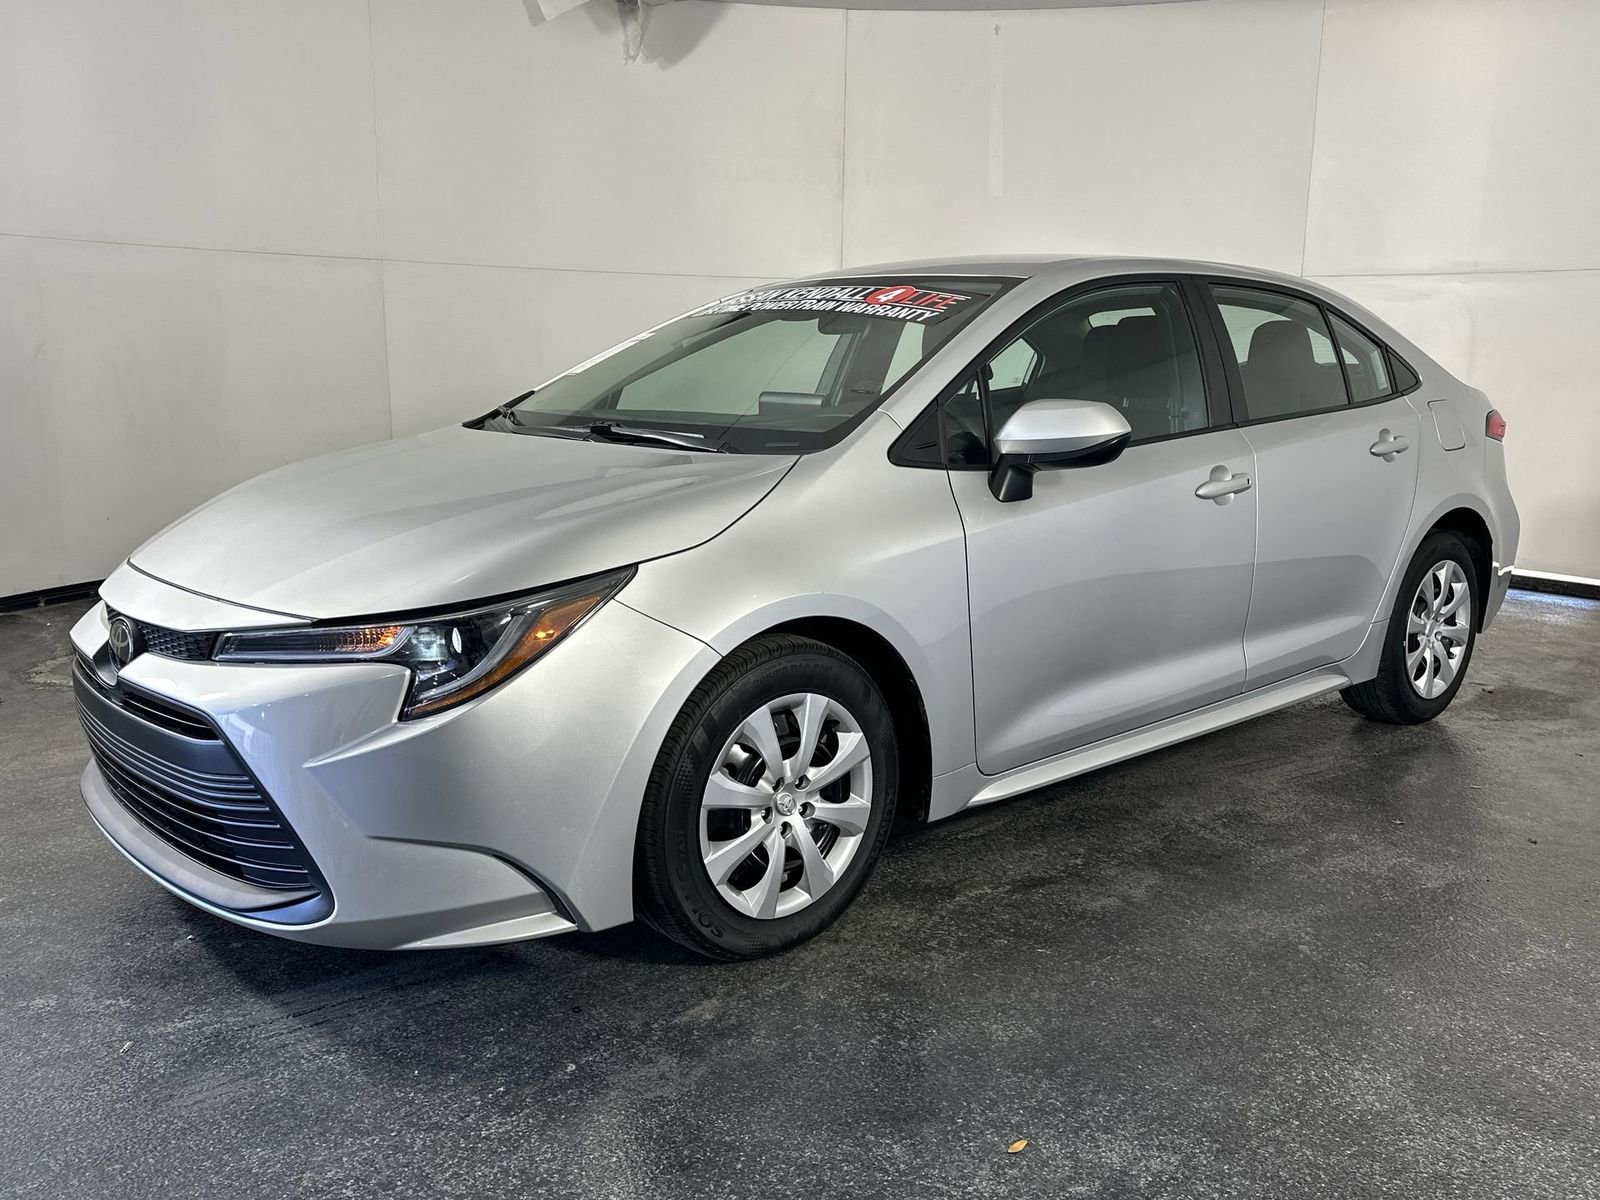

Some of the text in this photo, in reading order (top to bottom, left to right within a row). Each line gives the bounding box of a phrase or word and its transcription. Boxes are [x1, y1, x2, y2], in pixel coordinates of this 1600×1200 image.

[780, 287, 875, 299] KENDALL
[902, 292, 958, 309] LIFE
[742, 300, 844, 311] POWERTRAIN
[835, 301, 940, 321] WARRANTY
